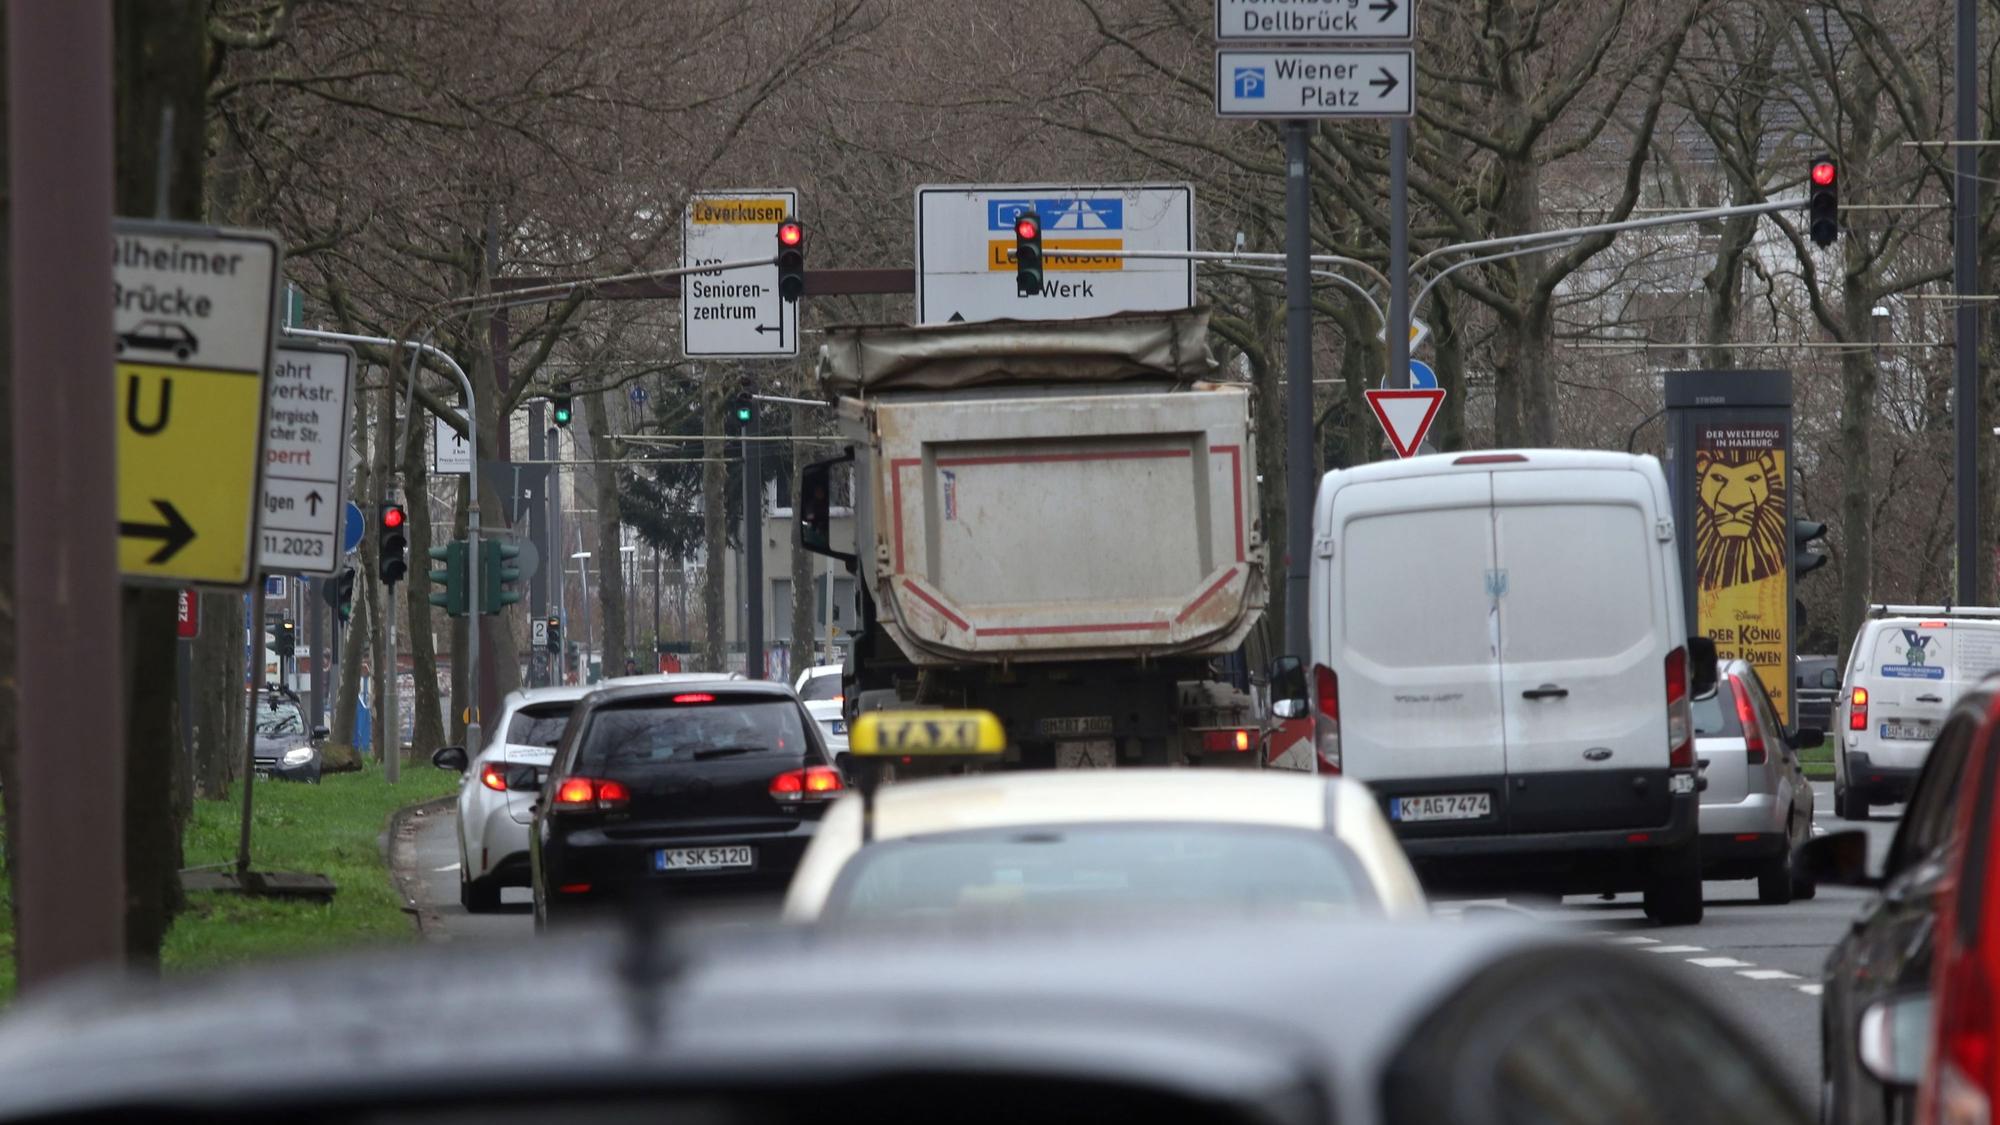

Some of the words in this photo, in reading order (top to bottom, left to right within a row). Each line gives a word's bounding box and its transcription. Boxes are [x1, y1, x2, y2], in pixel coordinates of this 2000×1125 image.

[1244, 10, 1358, 31] Dellbrück
[1275, 59, 1358, 79] Wiener
[1302, 86, 1359, 106] Platz
[696, 203, 784, 221] Leverkusen
[995, 246, 1117, 264] Lerkusen
[693, 280, 770, 298] Senioren-
[1041, 280, 1094, 298] Werk
[693, 303, 757, 320] zentrum
[126, 374, 172, 437] U
[1706, 430, 1724, 438] DER
[1726, 429, 1780, 438] WELTERFOLG
[1716, 439, 1727, 447] IN
[1729, 438, 1773, 447] HAMBURG
[535, 622, 545, 637] 2
[1708, 628, 1734, 641] DER
[1738, 625, 1782, 645] KÖNIG
[878, 719, 979, 749] TAXI
[1401, 799, 1412, 816] K
[1423, 798, 1445, 814] AG
[1448, 796, 1488, 813] 7474
[665, 852, 675, 866] K
[686, 851, 705, 865] SK
[710, 849, 750, 864] 5120
